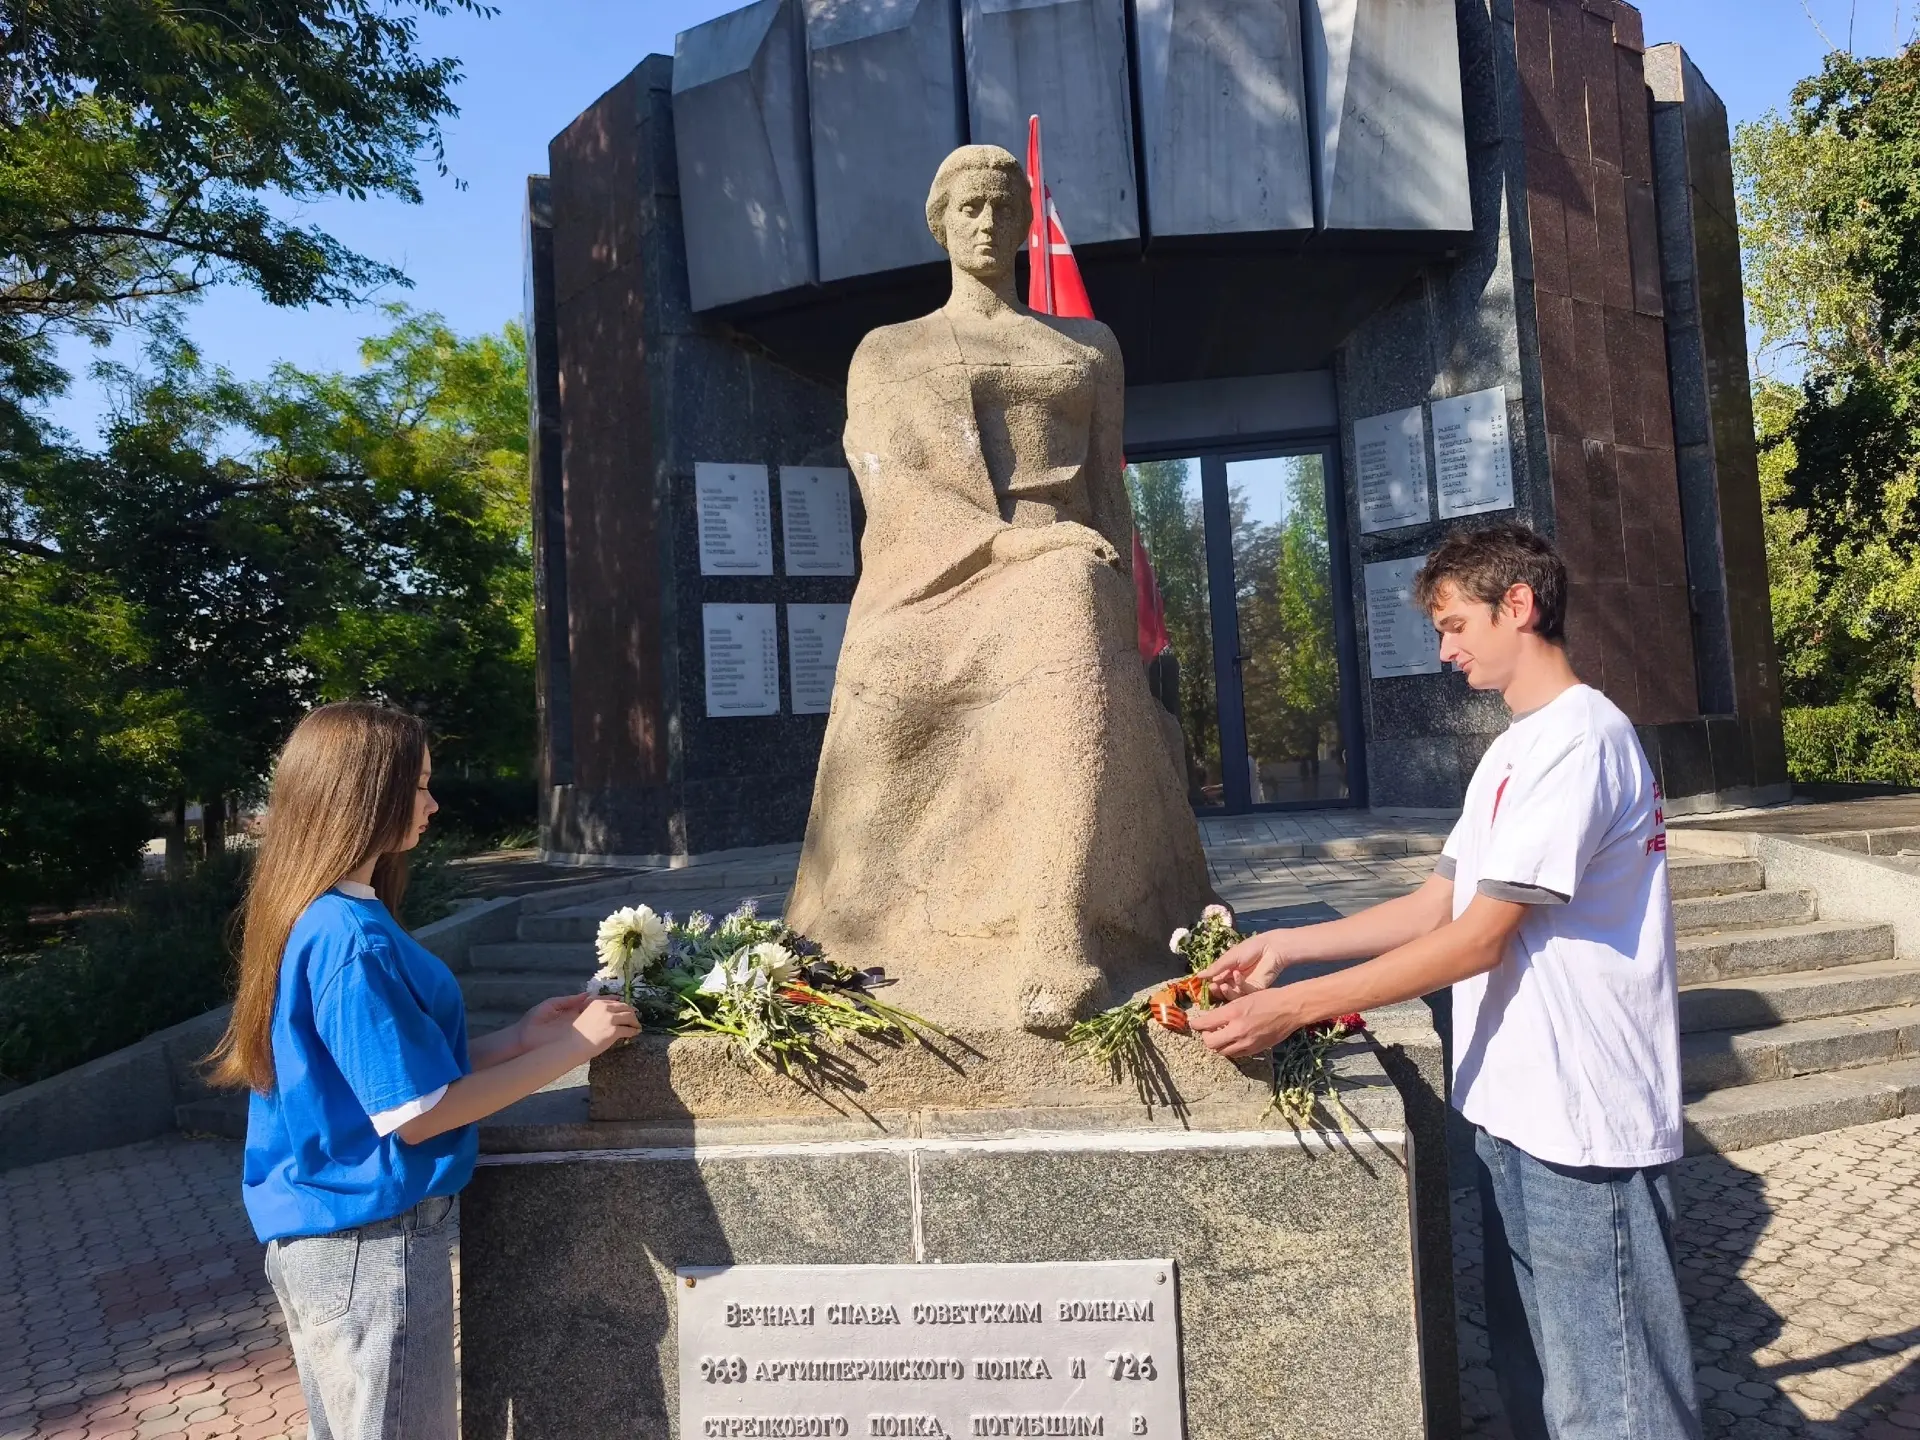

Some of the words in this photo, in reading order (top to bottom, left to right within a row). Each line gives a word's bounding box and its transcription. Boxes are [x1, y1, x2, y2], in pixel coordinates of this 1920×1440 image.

[725, 1302, 814, 1327] ВЕЧНАЯ
[825, 1302, 901, 1325] СЛАВА
[911, 1301, 1042, 1324] СОВЕТСКИМ
[1056, 1299, 1154, 1322] ВОИНАМ
[700, 1354, 747, 1384] 968
[972, 1356, 1052, 1379] ПОЛКА
[1068, 1356, 1087, 1380] И
[1104, 1351, 1157, 1381] 726
[702, 1413, 849, 1437] СТРЕЛКОВОГО
[971, 1413, 1104, 1437] ПОГИБШИМ
[1130, 1413, 1148, 1436] В
